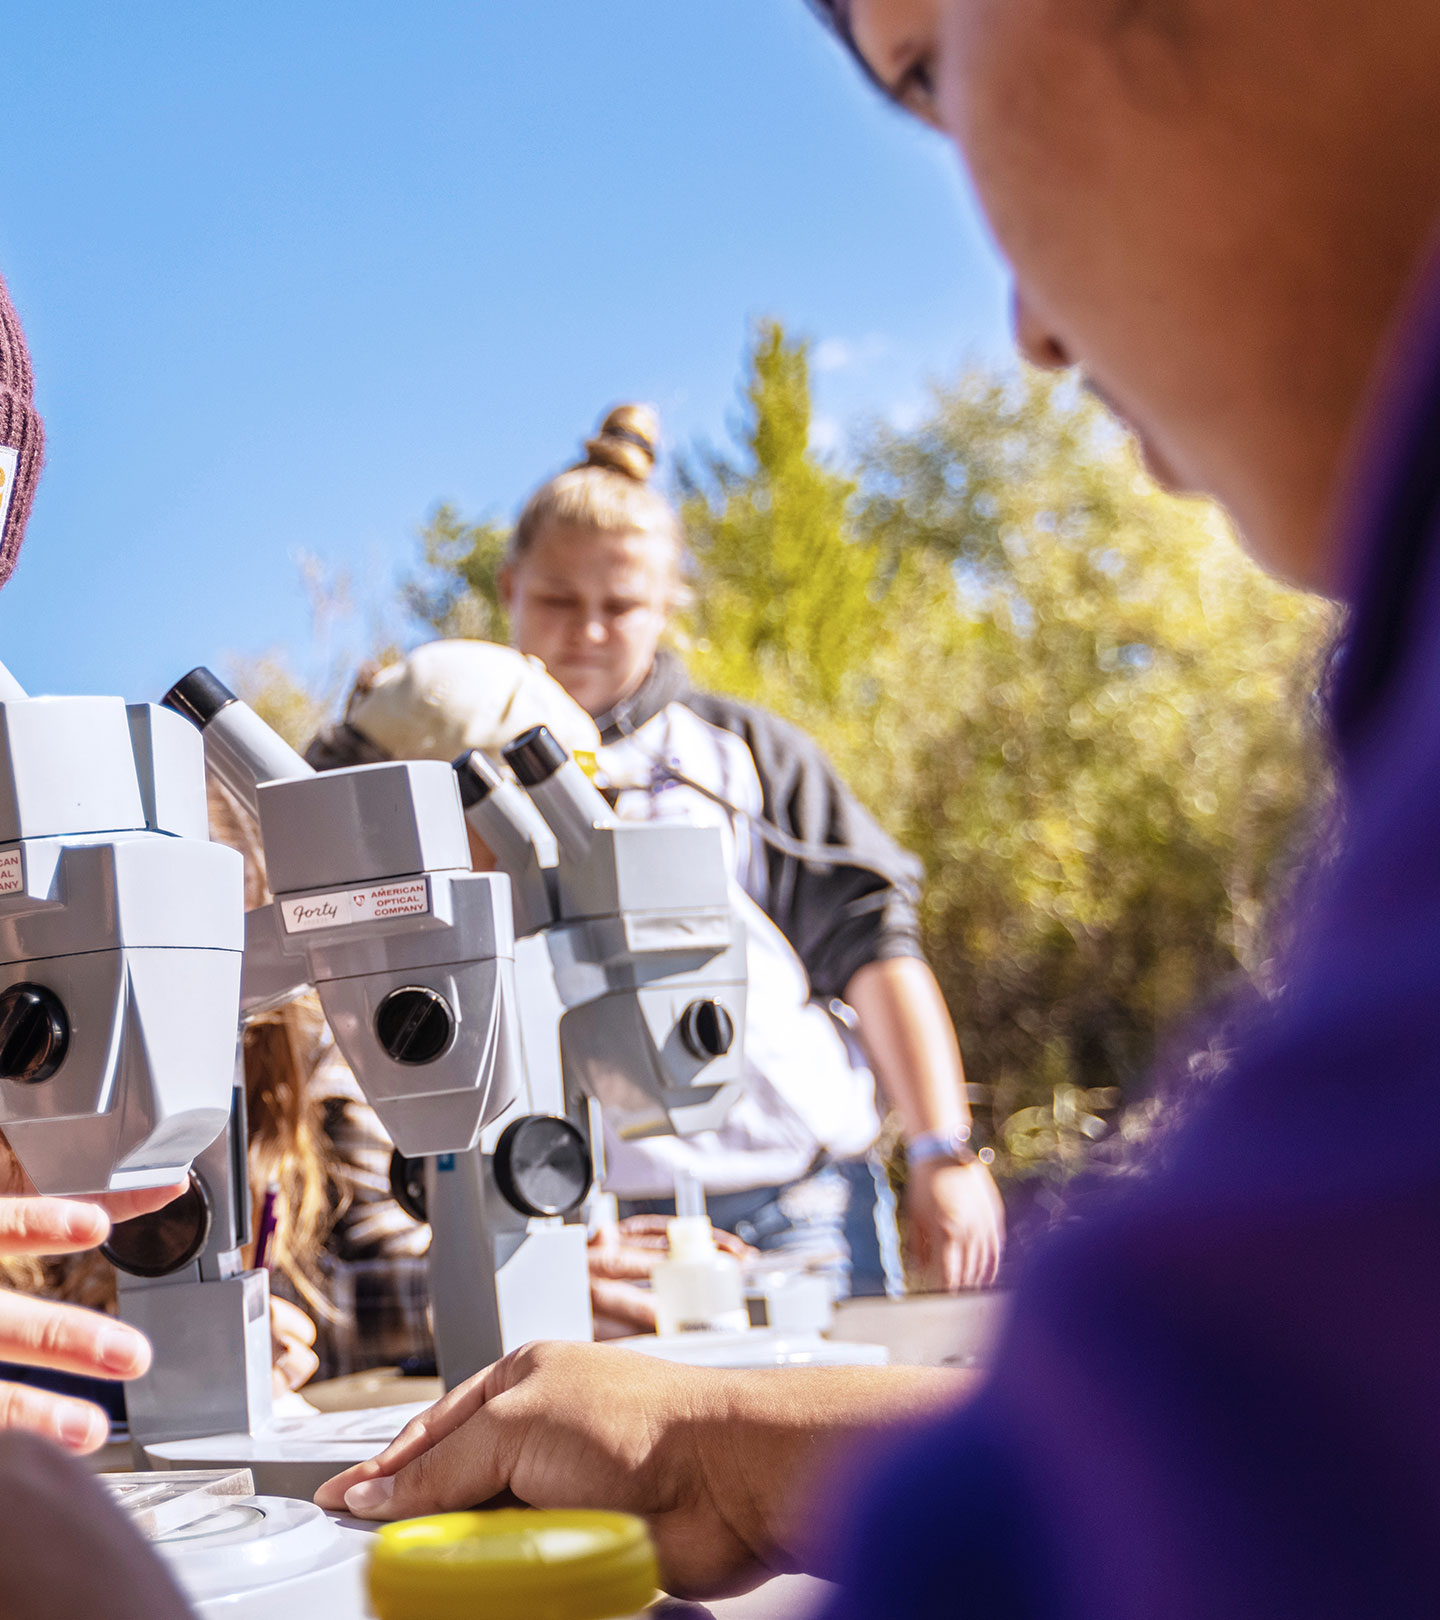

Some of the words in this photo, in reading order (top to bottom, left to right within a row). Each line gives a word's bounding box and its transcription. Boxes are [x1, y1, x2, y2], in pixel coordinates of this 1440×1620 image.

[371, 885, 424, 899] AMERICAN
[376, 896, 420, 907] OPTICAL
[374, 904, 424, 917] COMPANY
